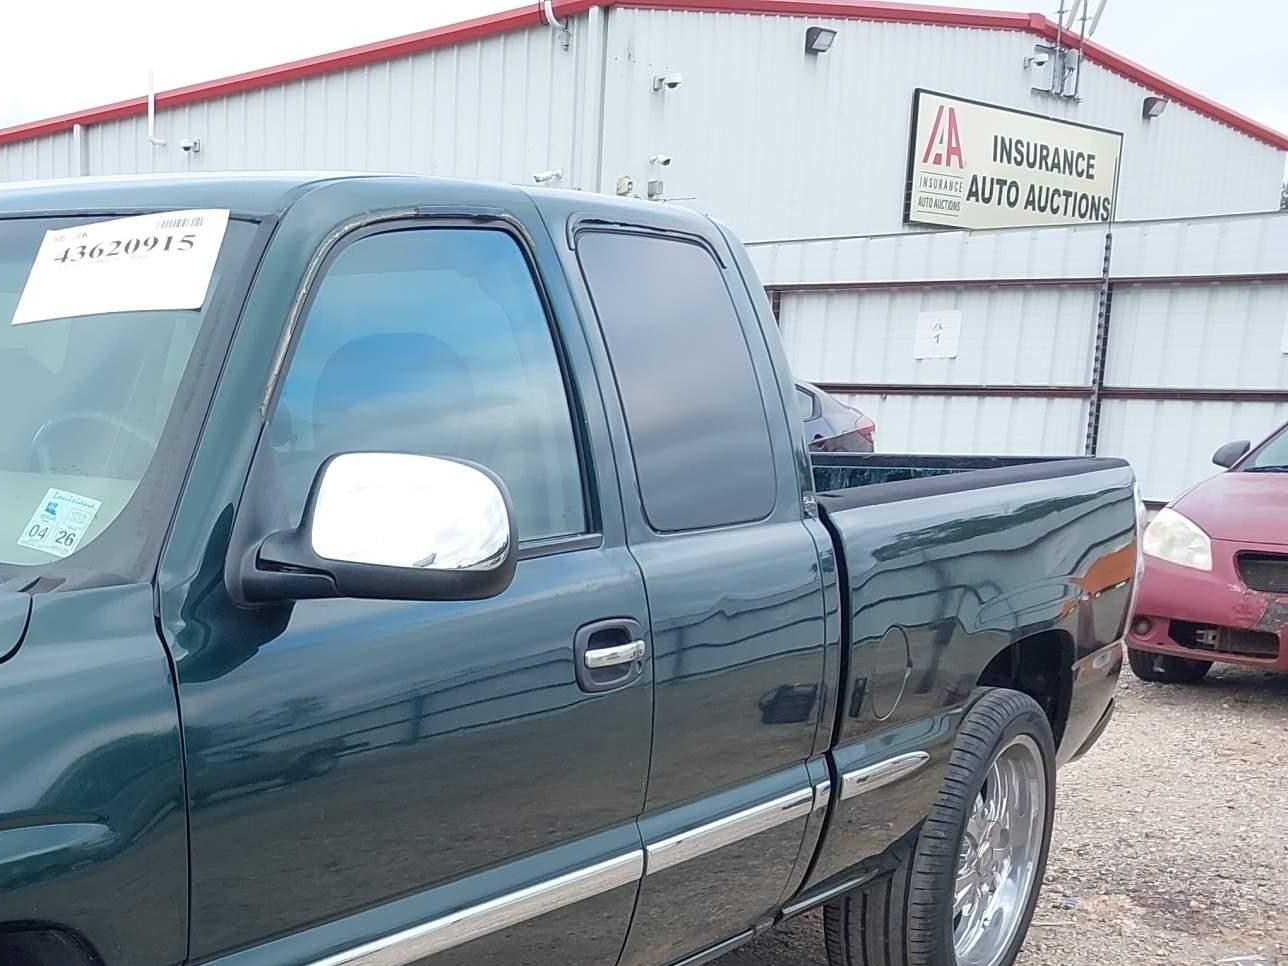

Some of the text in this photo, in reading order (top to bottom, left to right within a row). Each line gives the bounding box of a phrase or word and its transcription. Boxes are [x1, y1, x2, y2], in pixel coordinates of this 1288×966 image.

[992, 134, 1096, 180] INSURANCE
[919, 175, 963, 193] INSURANCE
[917, 195, 961, 212] AUTO AUCTIONS
[965, 174, 1111, 222] AUTO AUCTIONS
[53, 233, 197, 264] 43620915
[28, 524, 49, 540] 04
[55, 530, 76, 547] 26
